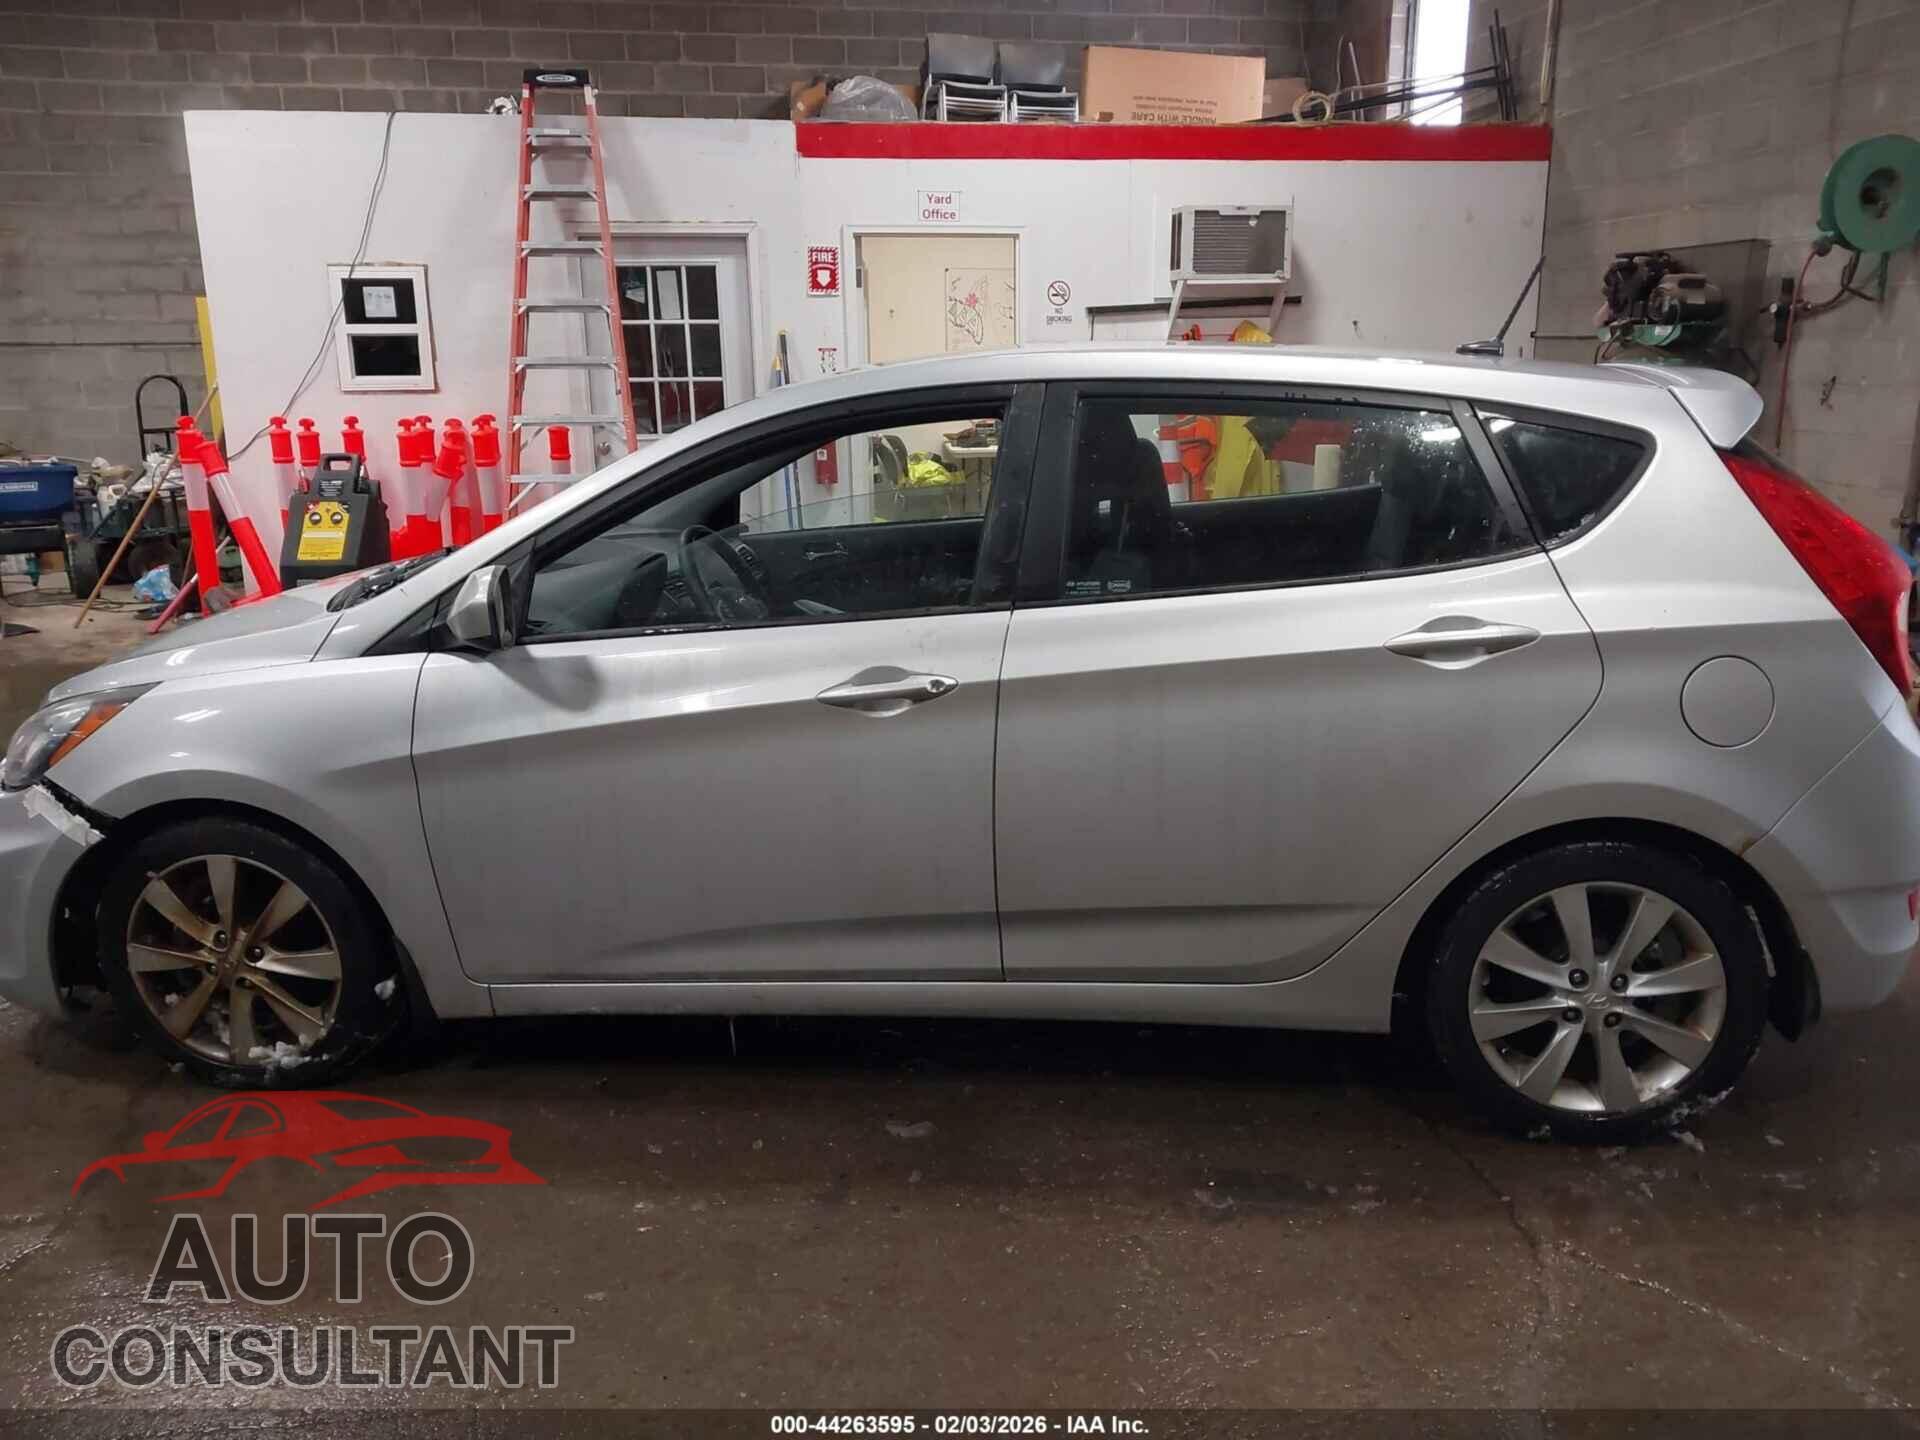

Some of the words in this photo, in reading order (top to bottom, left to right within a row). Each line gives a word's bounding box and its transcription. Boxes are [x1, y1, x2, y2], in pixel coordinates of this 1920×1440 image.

[1131, 112, 1155, 121] CARE
[1157, 113, 1179, 123] WITH
[926, 193, 952, 204] Yard
[922, 209, 956, 220] Office
[812, 251, 835, 262] FIRE
